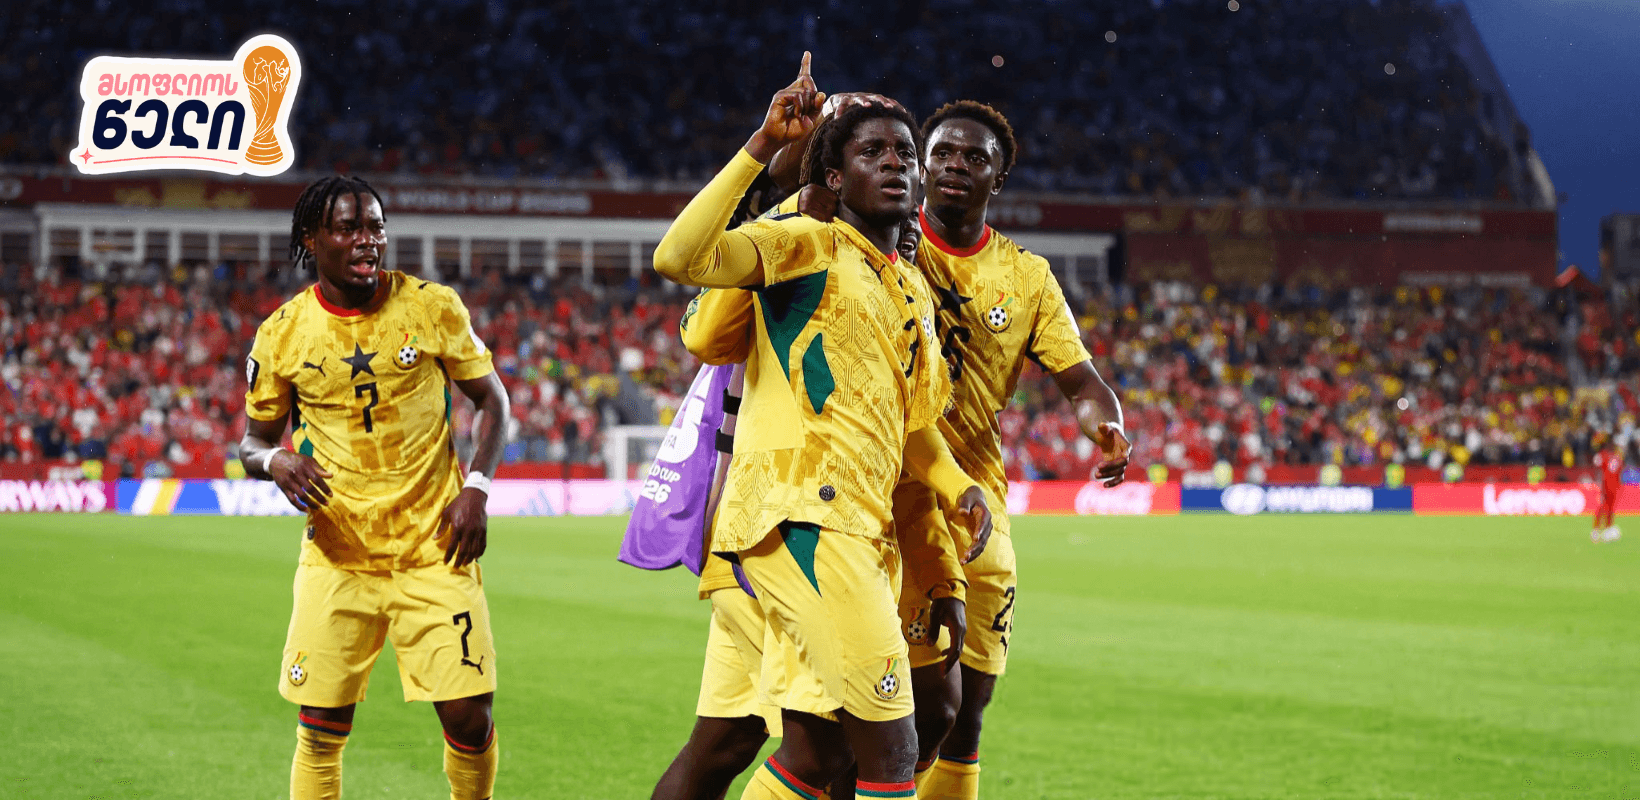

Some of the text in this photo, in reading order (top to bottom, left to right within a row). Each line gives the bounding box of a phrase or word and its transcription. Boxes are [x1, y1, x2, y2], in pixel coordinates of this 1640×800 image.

[354, 382, 379, 433] 7
[660, 467, 681, 483] CUP
[991, 586, 1016, 632] 2
[452, 611, 472, 658] 7
